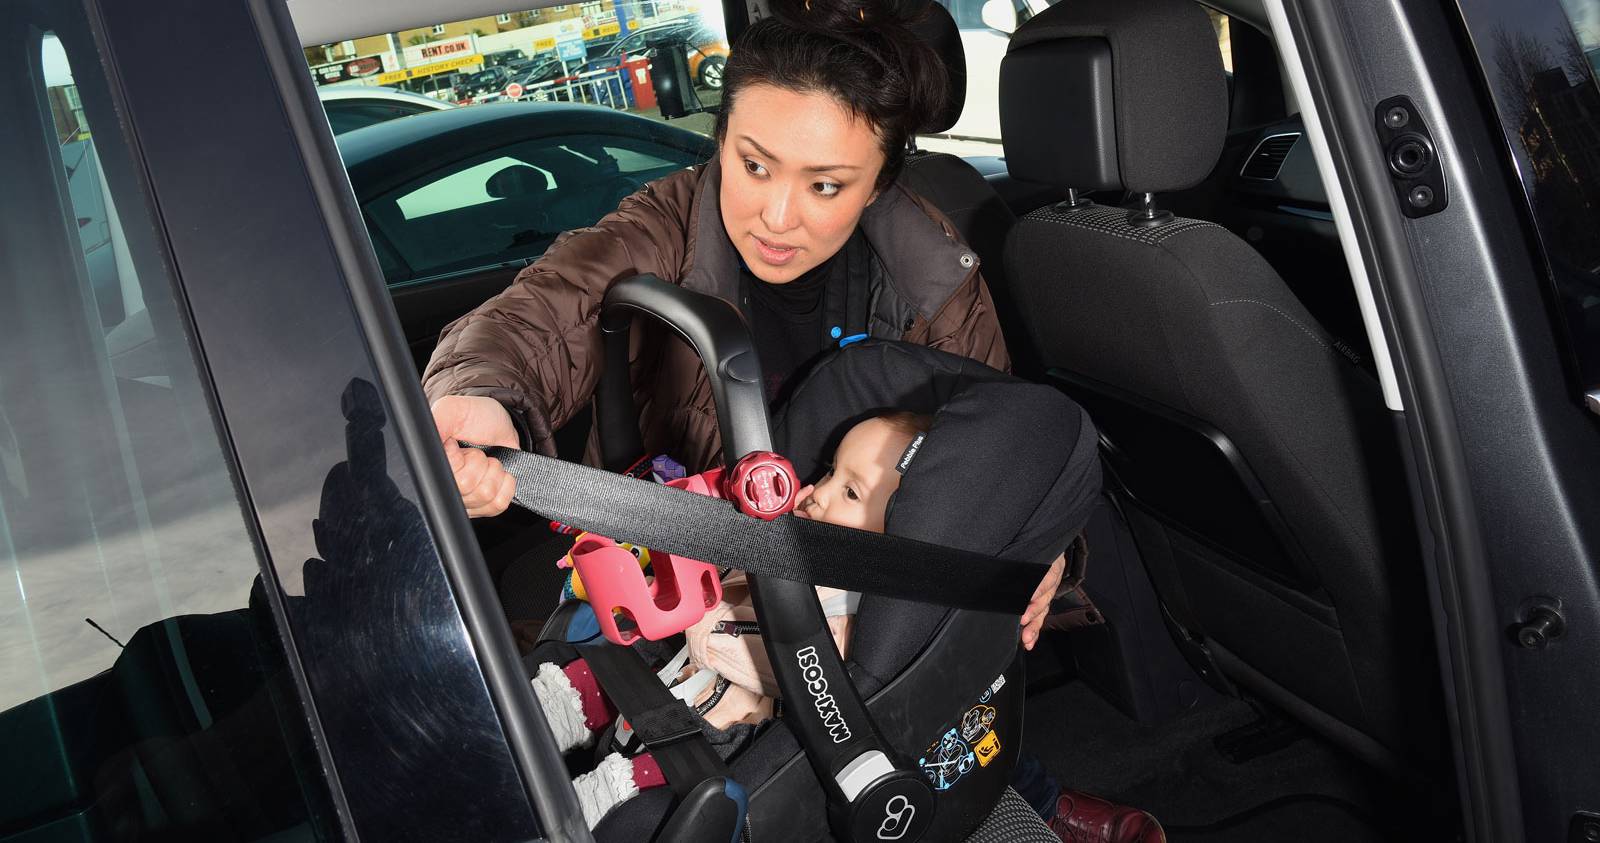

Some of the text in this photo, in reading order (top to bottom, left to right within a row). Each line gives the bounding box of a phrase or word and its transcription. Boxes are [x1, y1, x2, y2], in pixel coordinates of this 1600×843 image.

[384, 58, 474, 82] FREE HISTORY CHECK
[900, 436, 924, 469] Pebble Plus
